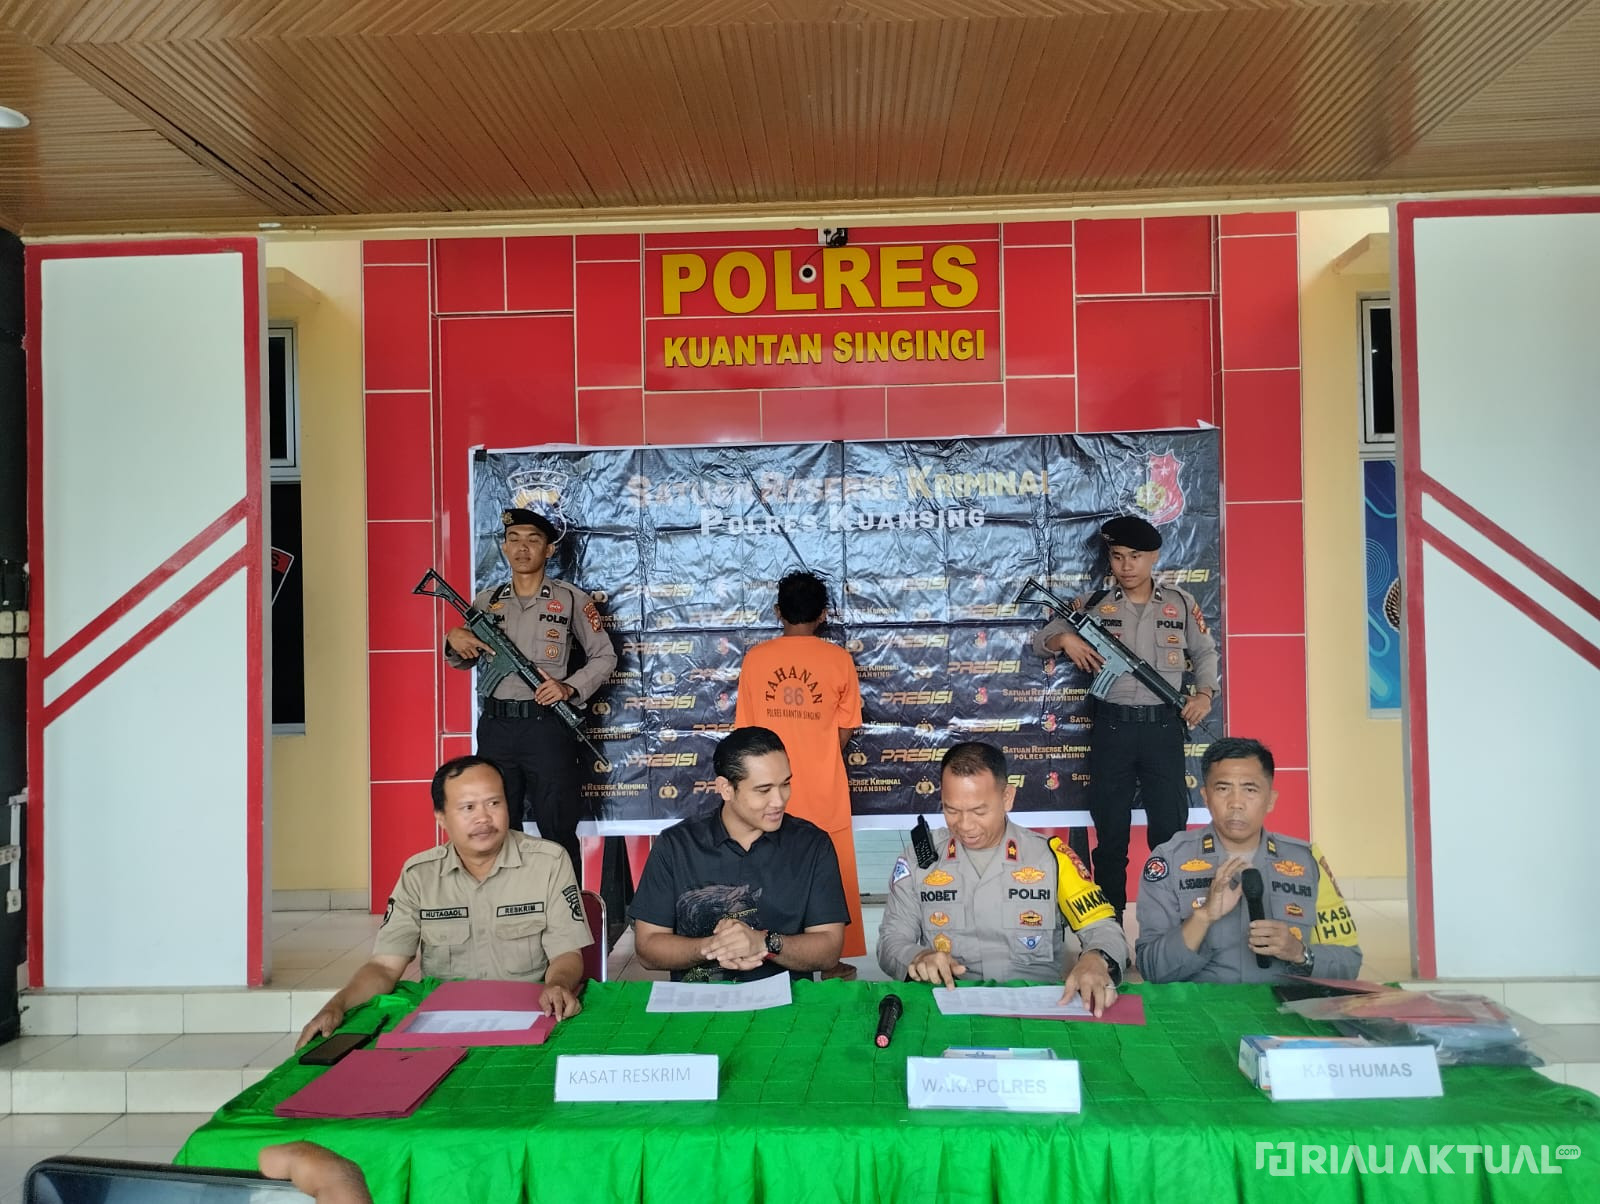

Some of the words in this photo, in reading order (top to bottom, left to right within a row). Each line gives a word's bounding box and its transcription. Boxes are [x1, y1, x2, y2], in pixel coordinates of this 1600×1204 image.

[662, 244, 979, 315] POLRES
[664, 333, 822, 368] KUANTAN
[833, 329, 985, 363] SINGINGI
[701, 508, 818, 536] POLRES
[829, 502, 985, 532] KUANSING
[1157, 620, 1184, 630] POLRI
[947, 660, 1021, 674] PRESISI
[765, 666, 823, 704] TAHANAN
[624, 695, 697, 710] PRESISI
[783, 685, 804, 707] 86
[880, 691, 953, 705] PRESISI
[1002, 745, 1030, 754] SATUAN
[1063, 744, 1092, 753] KRIMINA
[626, 752, 698, 767] PRESISI
[870, 777, 901, 786] KRIMINAL
[921, 890, 957, 902] ROBET
[1009, 888, 1051, 900] POLRI
[1272, 881, 1312, 897] POLRI
[504, 904, 537, 914] RESKRIM
[569, 1069, 618, 1085] KASAT
[623, 1067, 691, 1083] RESKRIM
[1303, 1063, 1345, 1078] KASI
[1350, 1062, 1413, 1078] HUMAS
